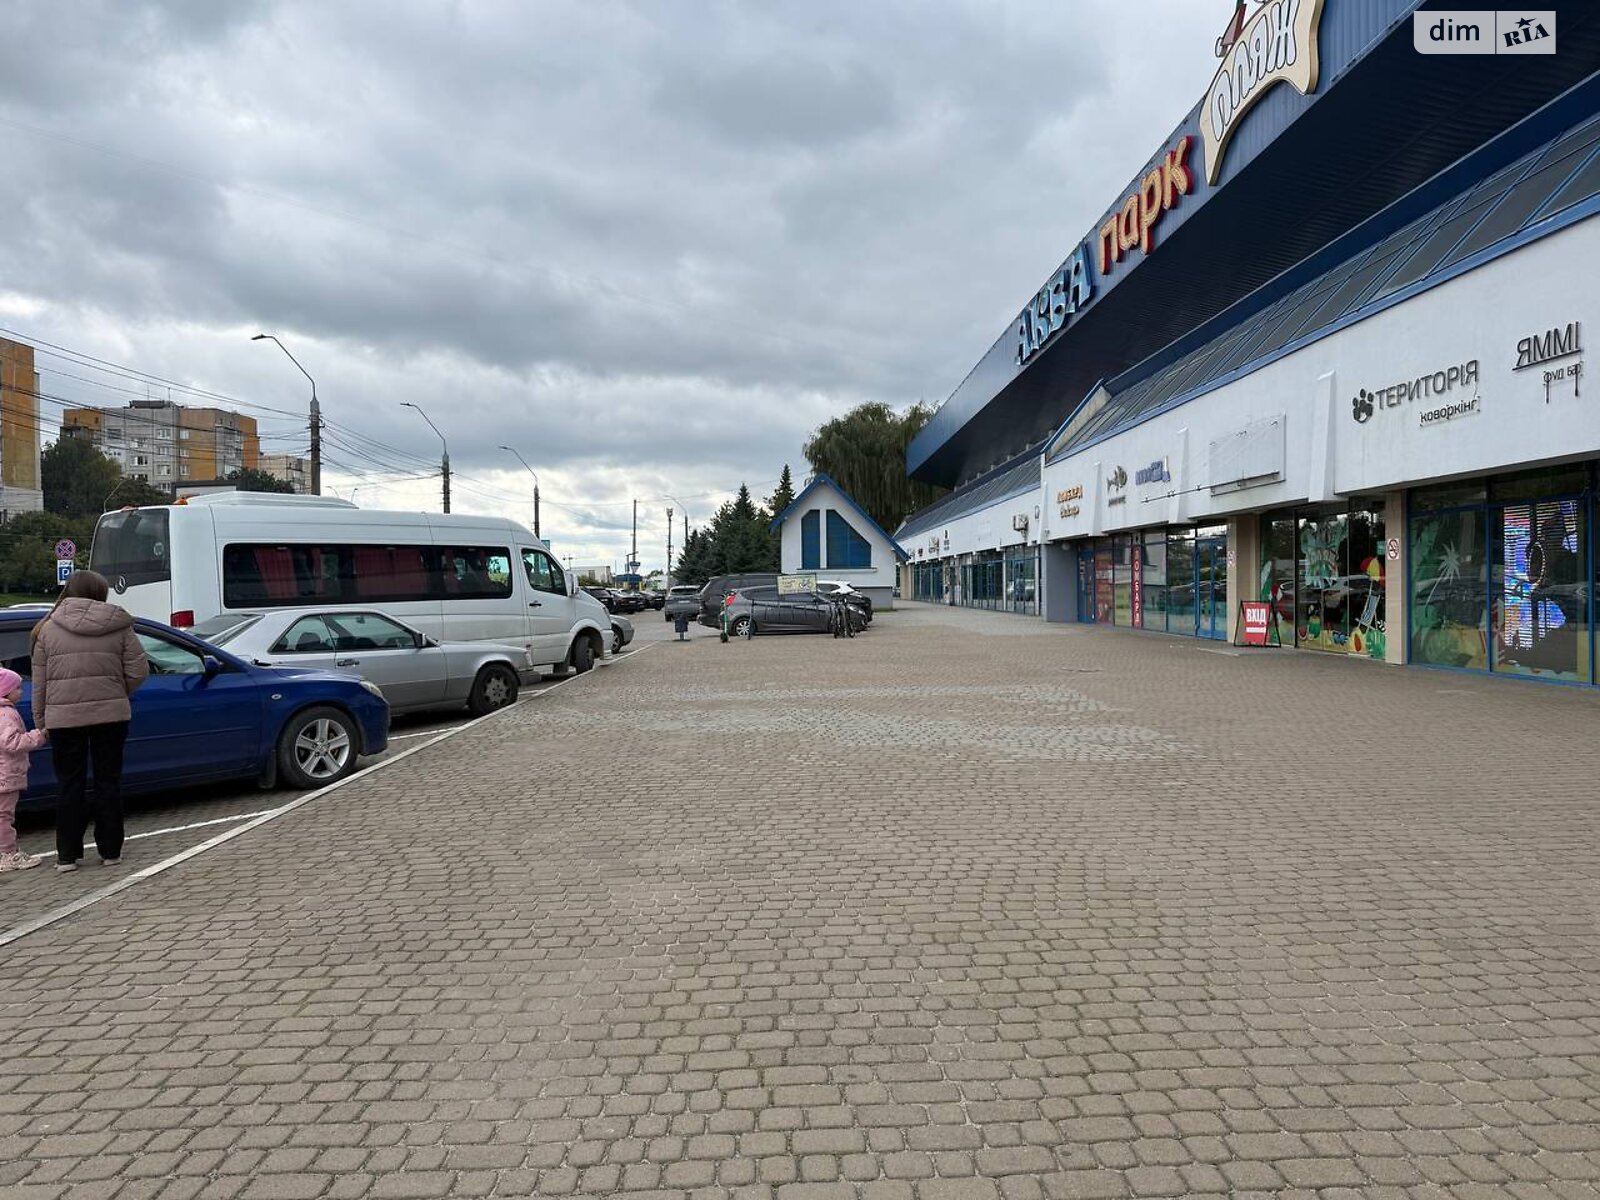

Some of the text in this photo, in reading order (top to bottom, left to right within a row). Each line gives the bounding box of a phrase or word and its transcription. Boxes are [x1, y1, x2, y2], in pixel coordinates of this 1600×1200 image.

[1211, 0, 1301, 142] ПЛЯЖ
[1016, 241, 1094, 366] АКВА
[1515, 321, 1581, 367] ЯММІ
[1375, 359, 1479, 411] ТЕРИТОРІЯ
[1419, 399, 1479, 423] коворкінг
[1246, 608, 1267, 625] ВХІД
